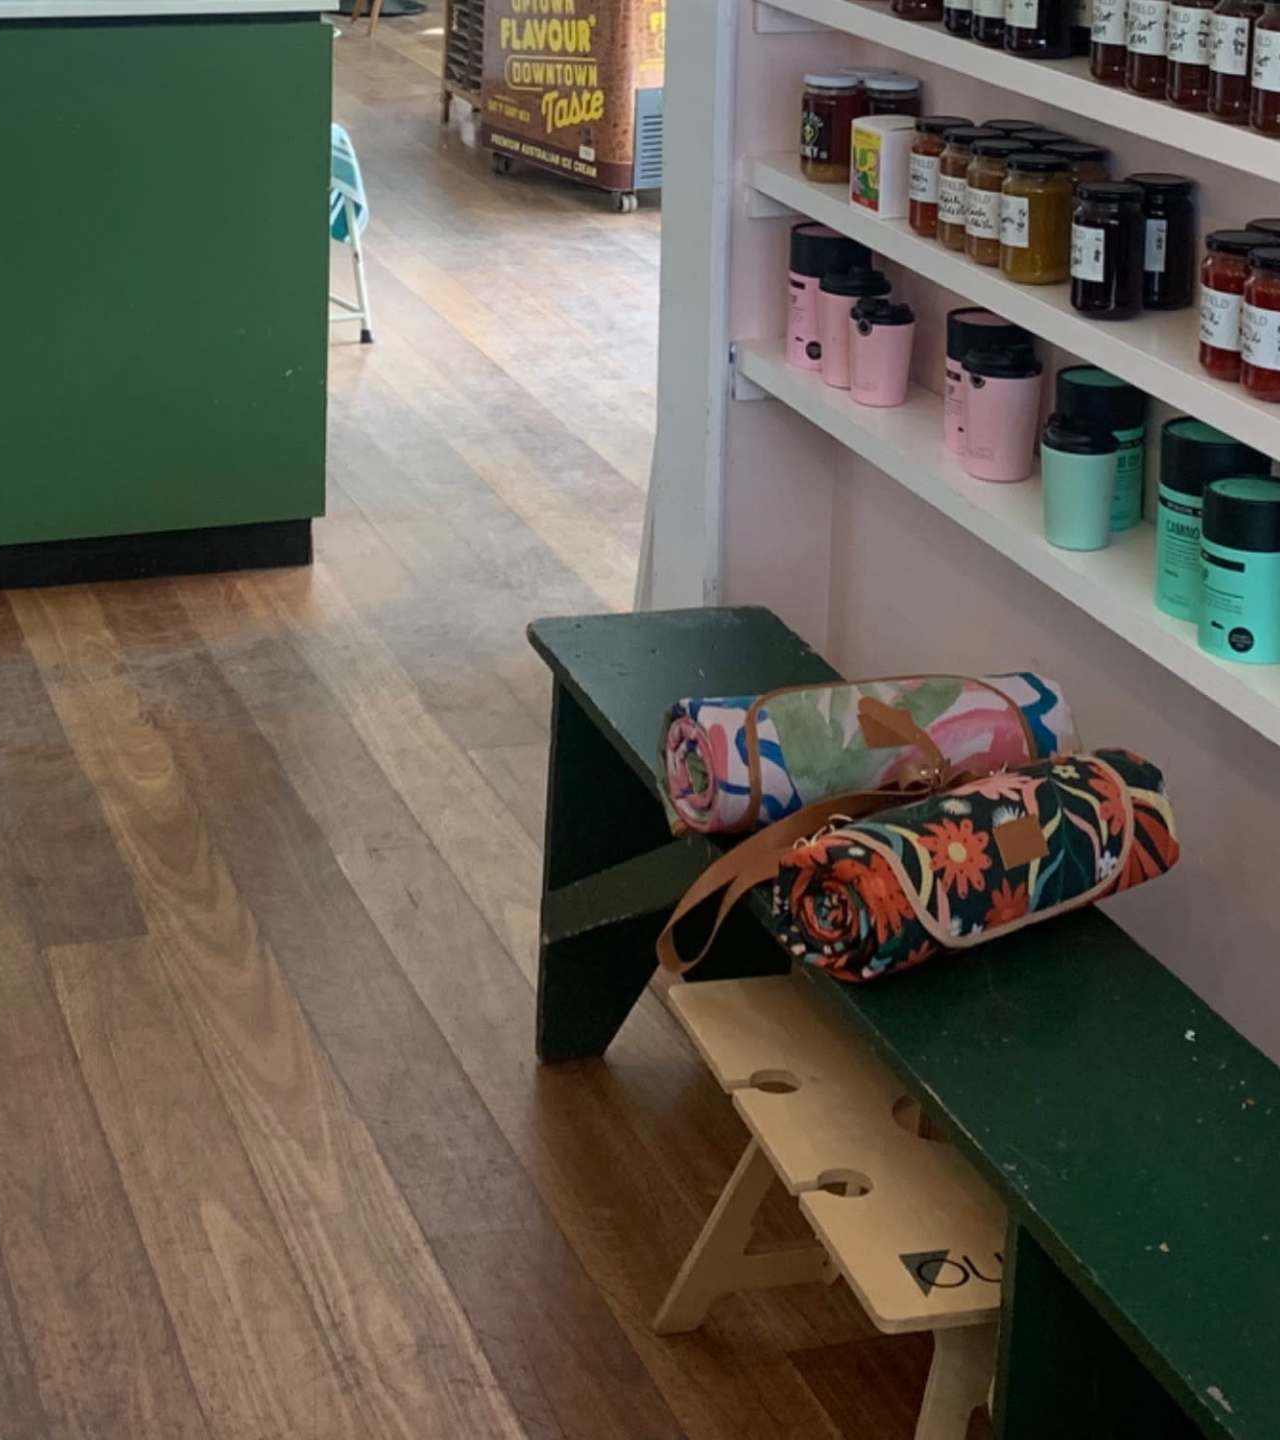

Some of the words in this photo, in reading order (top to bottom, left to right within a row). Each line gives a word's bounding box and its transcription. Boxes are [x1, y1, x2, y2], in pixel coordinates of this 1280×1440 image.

[500, 17, 592, 52] FLAVOUR
[512, 61, 598, 88] DOWNTOWN
[542, 89, 605, 133] Taste
